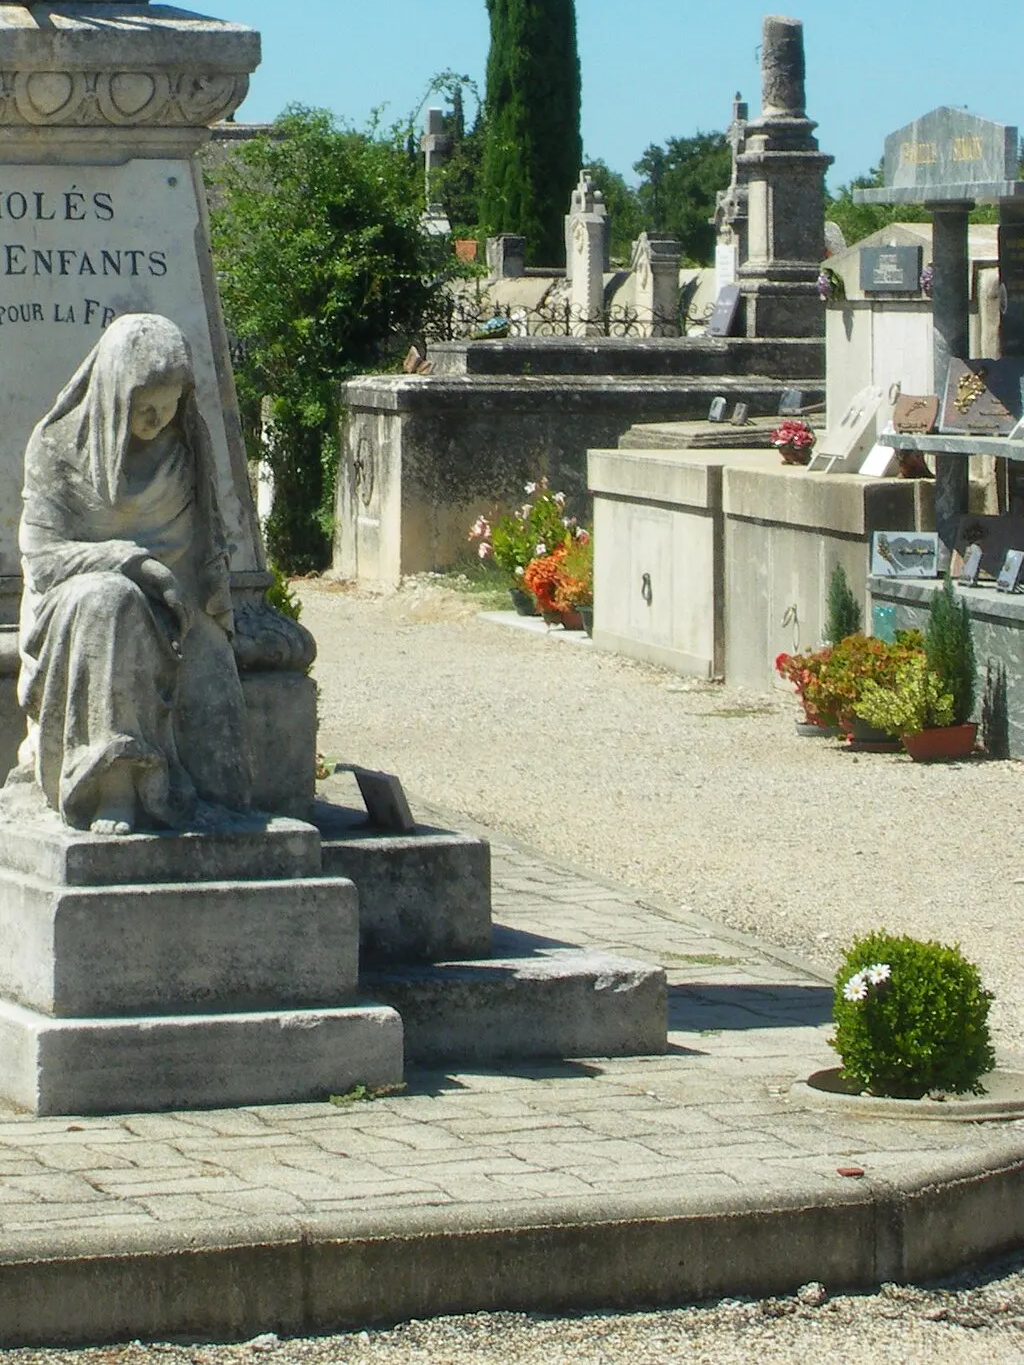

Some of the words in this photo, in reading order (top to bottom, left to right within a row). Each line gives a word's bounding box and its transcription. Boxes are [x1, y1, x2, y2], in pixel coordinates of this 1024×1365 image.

[4, 244, 168, 277] ENFANTS
[54, 303, 76, 324] LA
[82, 298, 116, 329] FR
